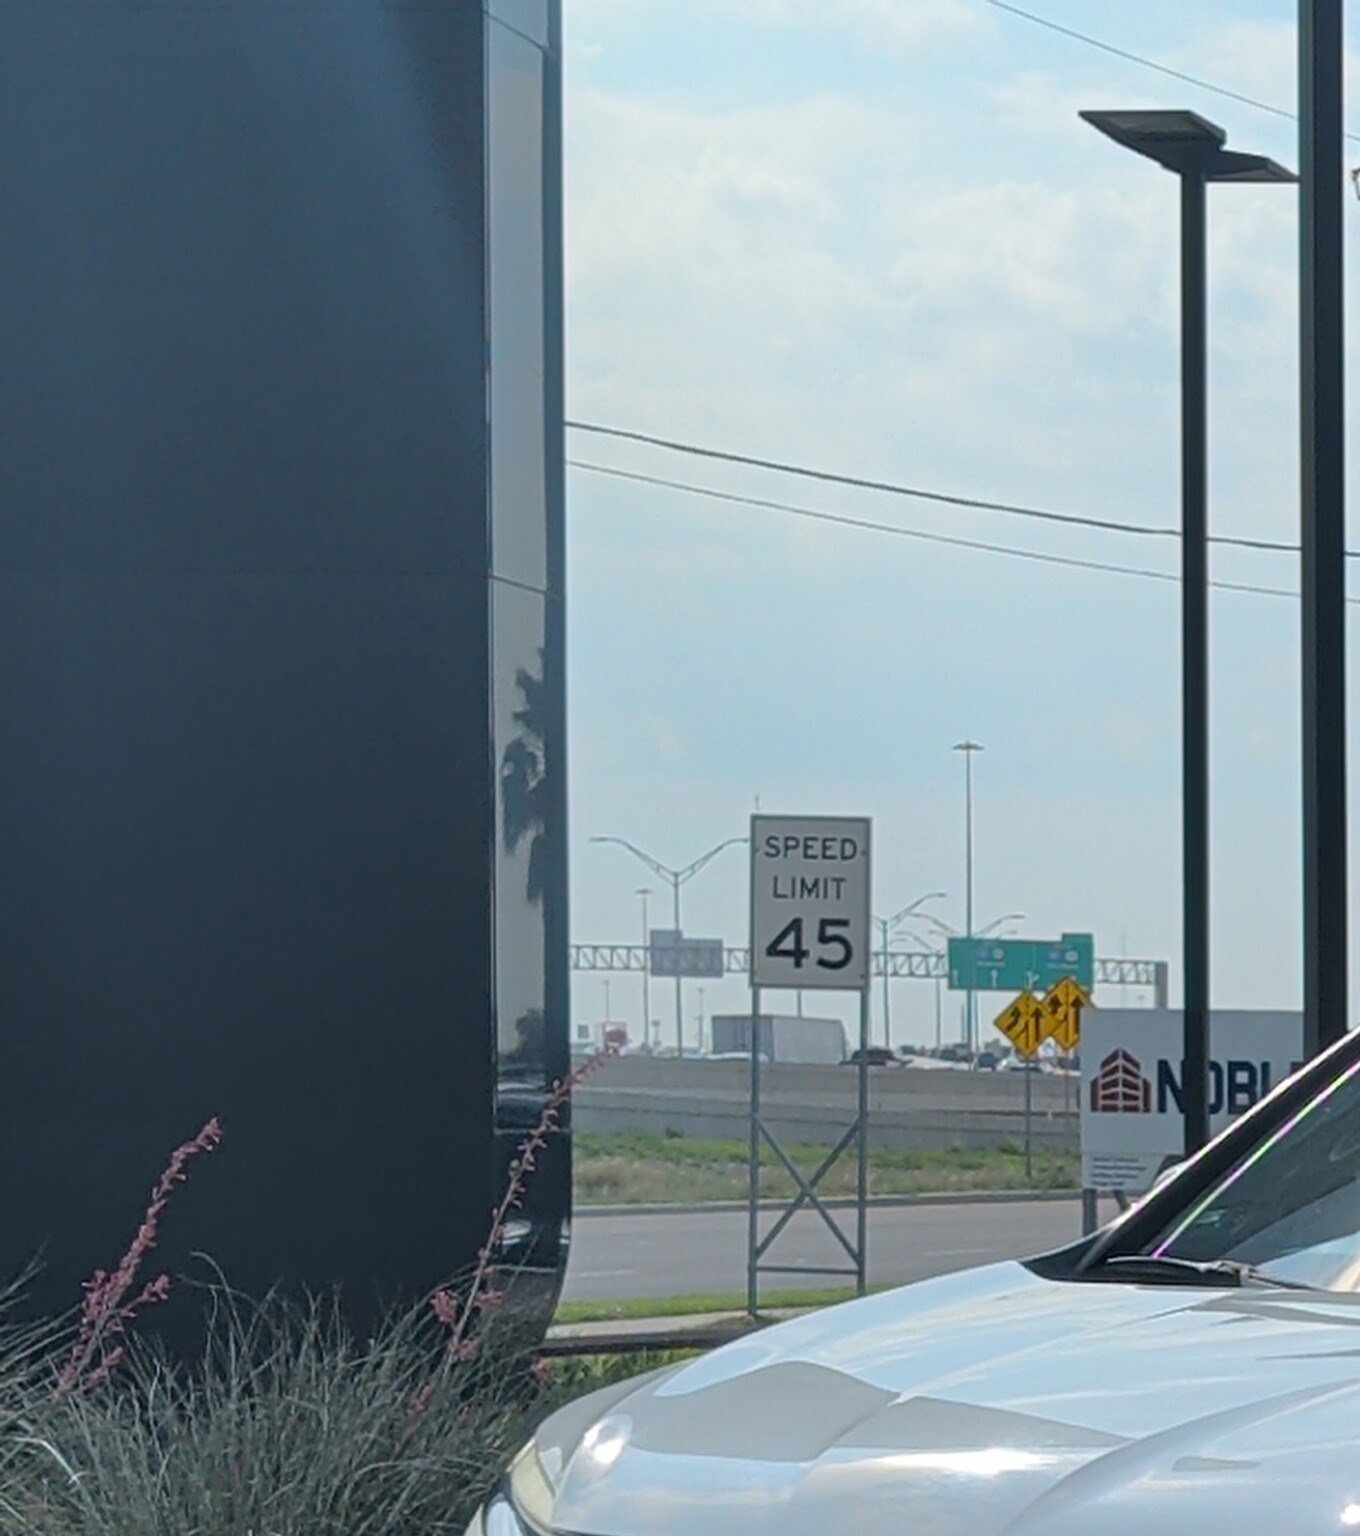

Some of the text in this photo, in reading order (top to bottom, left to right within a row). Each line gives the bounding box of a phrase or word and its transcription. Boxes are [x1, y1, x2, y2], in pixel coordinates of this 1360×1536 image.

[764, 835, 858, 861] SPEED
[772, 876, 848, 900] LIMIT
[765, 916, 854, 970] 45
